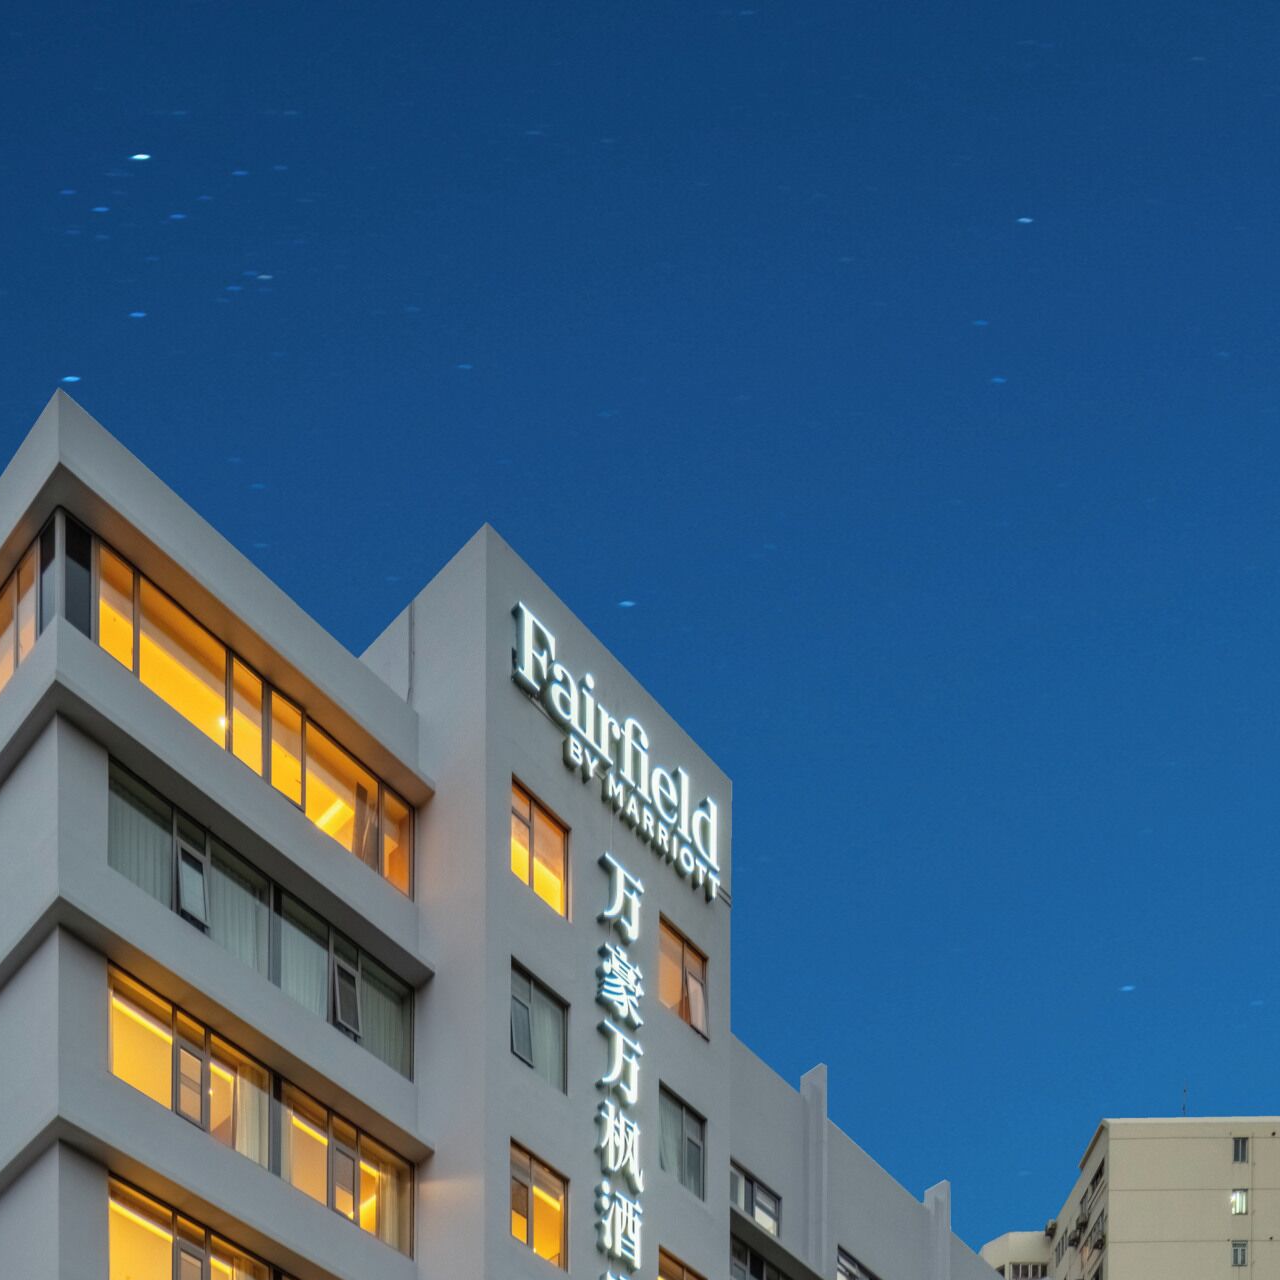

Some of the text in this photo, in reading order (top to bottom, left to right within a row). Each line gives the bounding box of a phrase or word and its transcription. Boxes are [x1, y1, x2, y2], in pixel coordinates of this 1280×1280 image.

[514, 600, 720, 873] Fairfield
[568, 738, 721, 899] BY MARRIOTT
